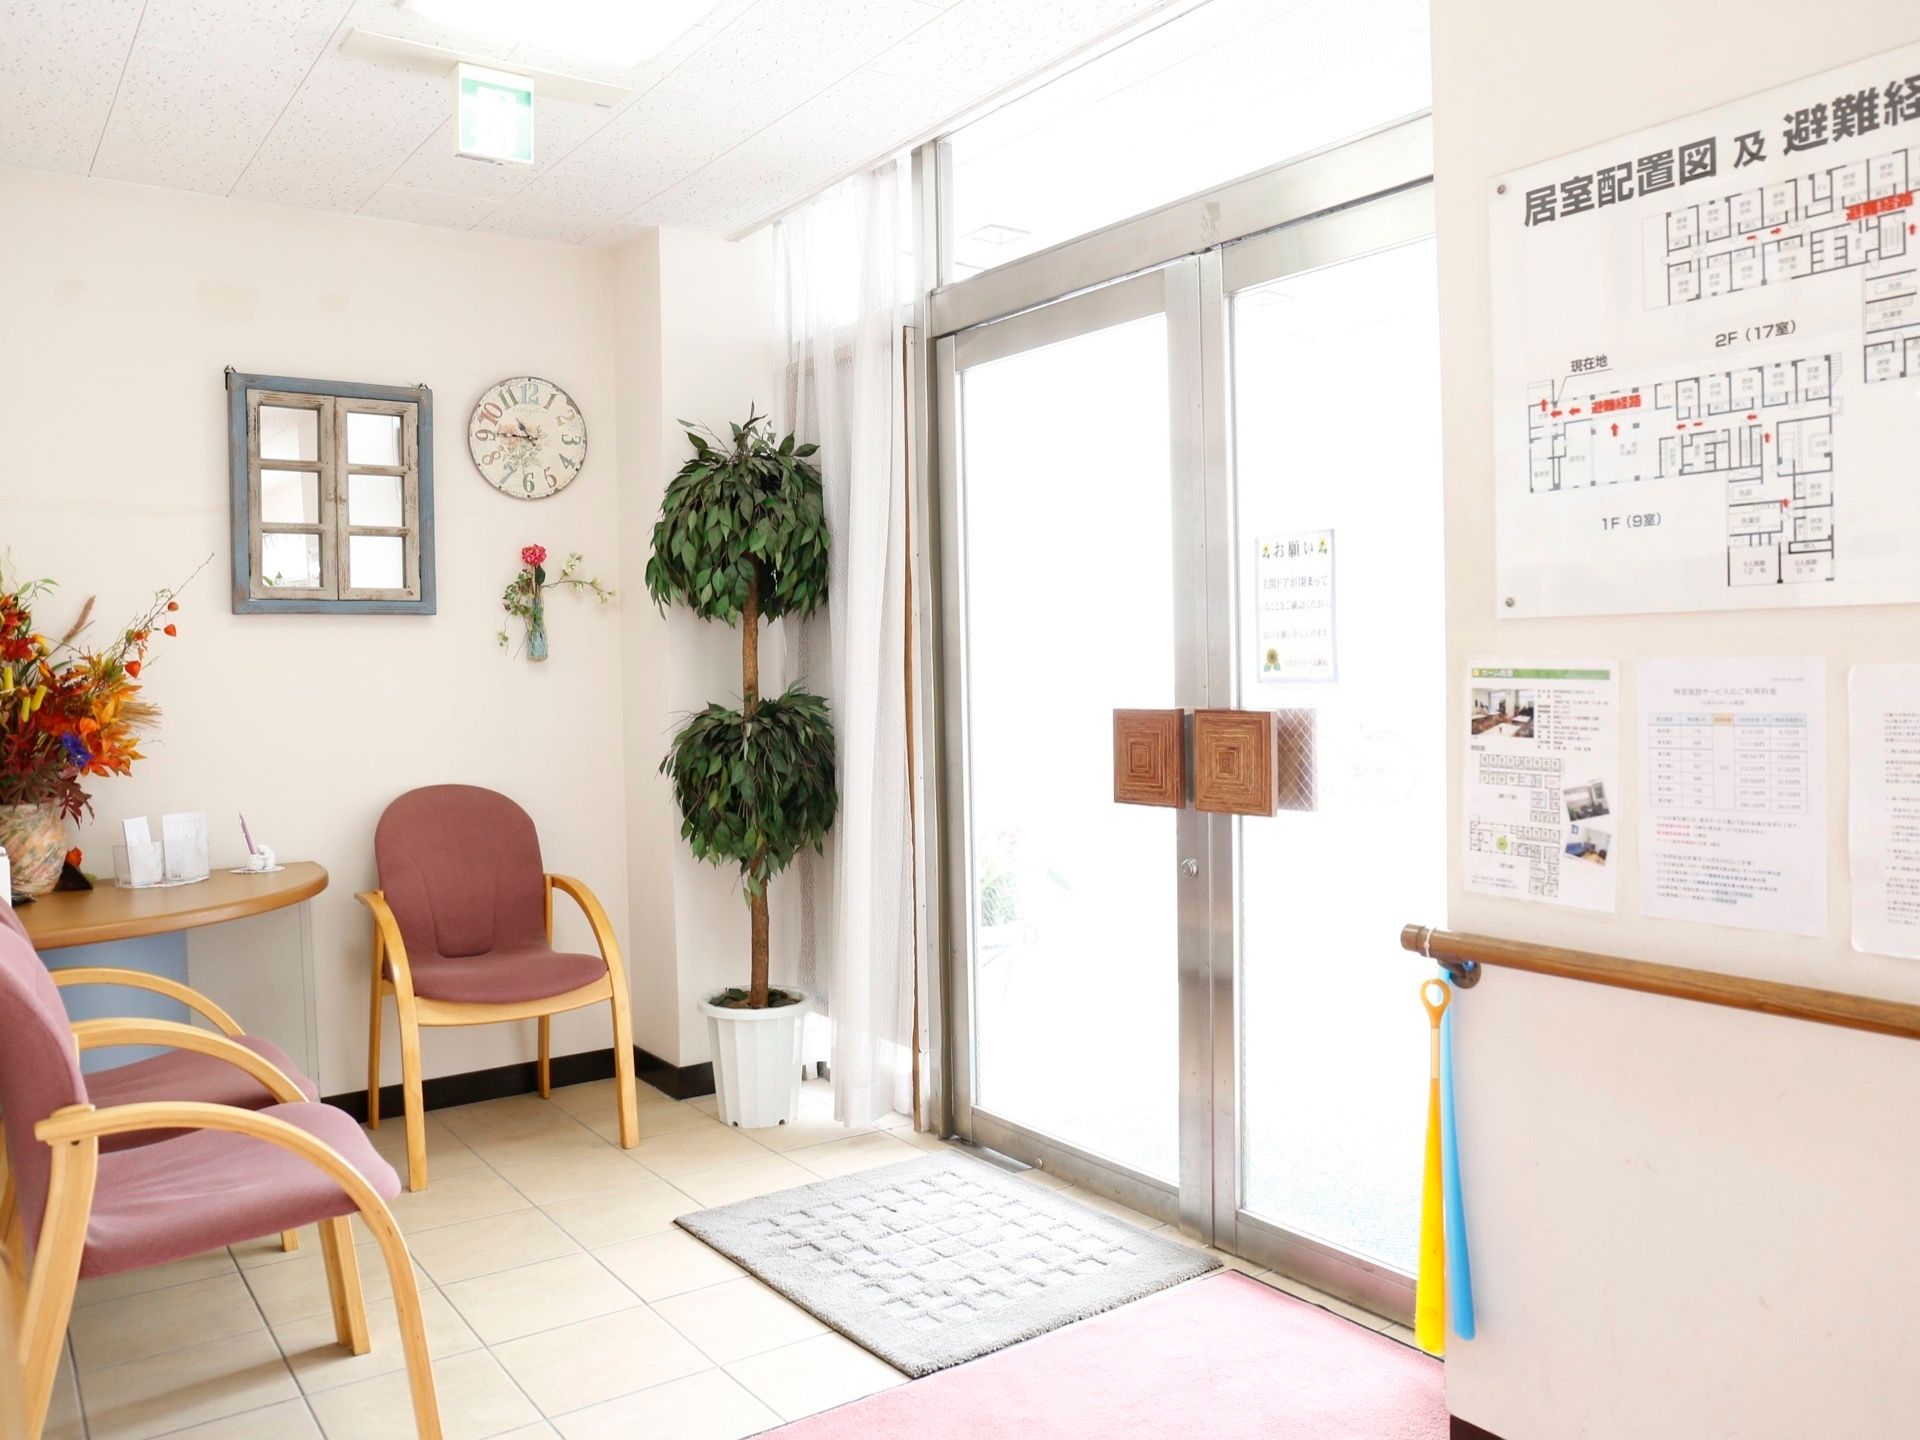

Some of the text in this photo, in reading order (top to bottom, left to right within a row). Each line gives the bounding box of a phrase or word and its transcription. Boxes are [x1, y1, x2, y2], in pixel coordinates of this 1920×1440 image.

[1524, 73, 1920, 228] 居室配置図 及 避難経
[1570, 354, 1608, 373] 現在地
[499, 386, 519, 409] 11
[519, 383, 541, 406] 12
[543, 393, 558, 409] 1
[478, 402, 502, 426] 10
[556, 410, 576, 426] 2
[475, 429, 495, 442] 9
[561, 434, 582, 446] 3
[482, 451, 502, 466] 8
[559, 453, 577, 470] 4
[499, 464, 518, 485] 7
[522, 472, 535, 493] 6
[543, 466, 557, 489] 5
[1274, 540, 1314, 558] お願い
